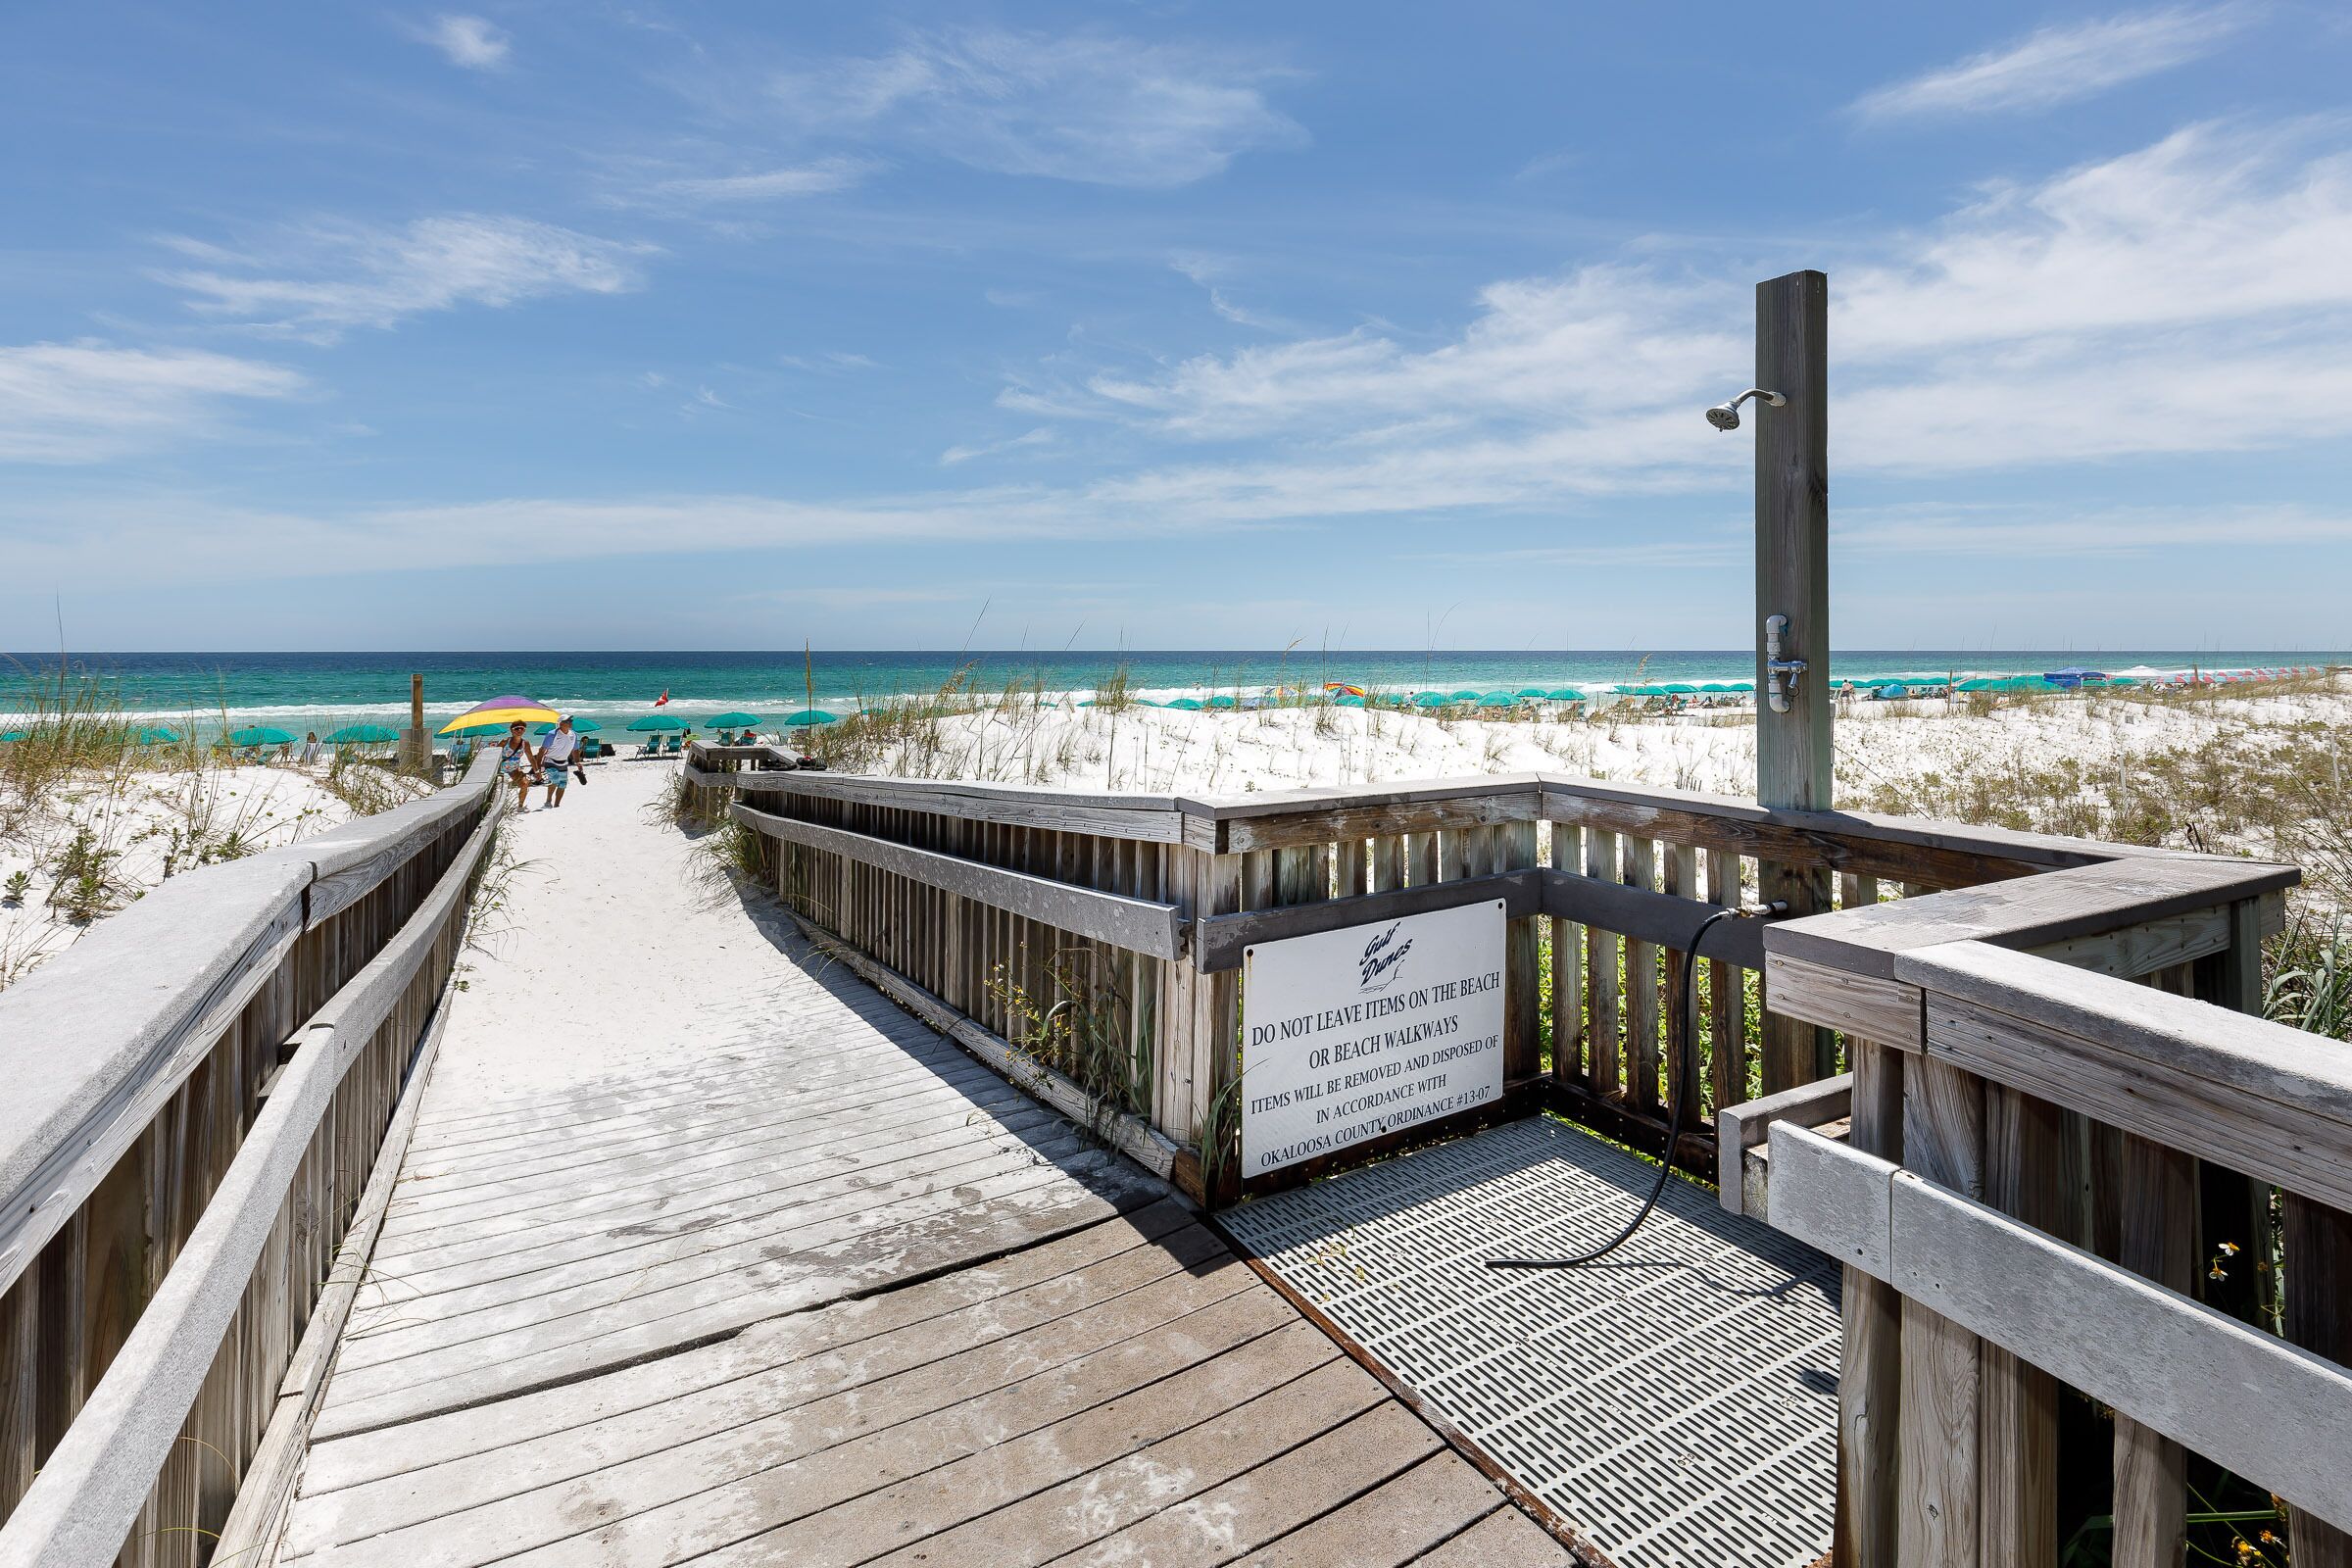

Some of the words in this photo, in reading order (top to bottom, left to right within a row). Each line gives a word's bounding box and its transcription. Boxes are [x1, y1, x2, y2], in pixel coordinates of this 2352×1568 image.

[1359, 921, 1401, 966] Gulf
[1361, 939, 1413, 987] Dunes
[1252, 1025, 1276, 1046] DO
[1280, 1015, 1313, 1040] NOT
[1317, 1004, 1362, 1032] LEAVE
[1365, 994, 1405, 1020] ITEMS
[1408, 991, 1428, 1008] ON
[1432, 983, 1457, 1004] THE
[1460, 971, 1500, 996] BEACH
[1309, 1049, 1330, 1069] OR
[1334, 1035, 1381, 1064] BEACH
[1385, 1015, 1458, 1049] WALKWAYS
[1250, 1092, 1290, 1114] ITEMS
[1294, 1082, 1323, 1102] WILL
[1327, 1077, 1342, 1093] BE
[1345, 1061, 1401, 1091] REMOVED
[1404, 1055, 1430, 1071] AND
[1433, 1042, 1483, 1066] DISPOSED
[1485, 1035, 1499, 1050] OF
[1316, 1109, 1330, 1123] IN
[1333, 1084, 1414, 1119] ACCORDANCE
[1418, 1074, 1446, 1093] WITH
[1260, 1136, 1332, 1167] OKALOOSA
[1335, 1115, 1386, 1144] COUNTY
[1388, 1097, 1454, 1128] ORDINANCE
[1456, 1086, 1490, 1106] #13-07
